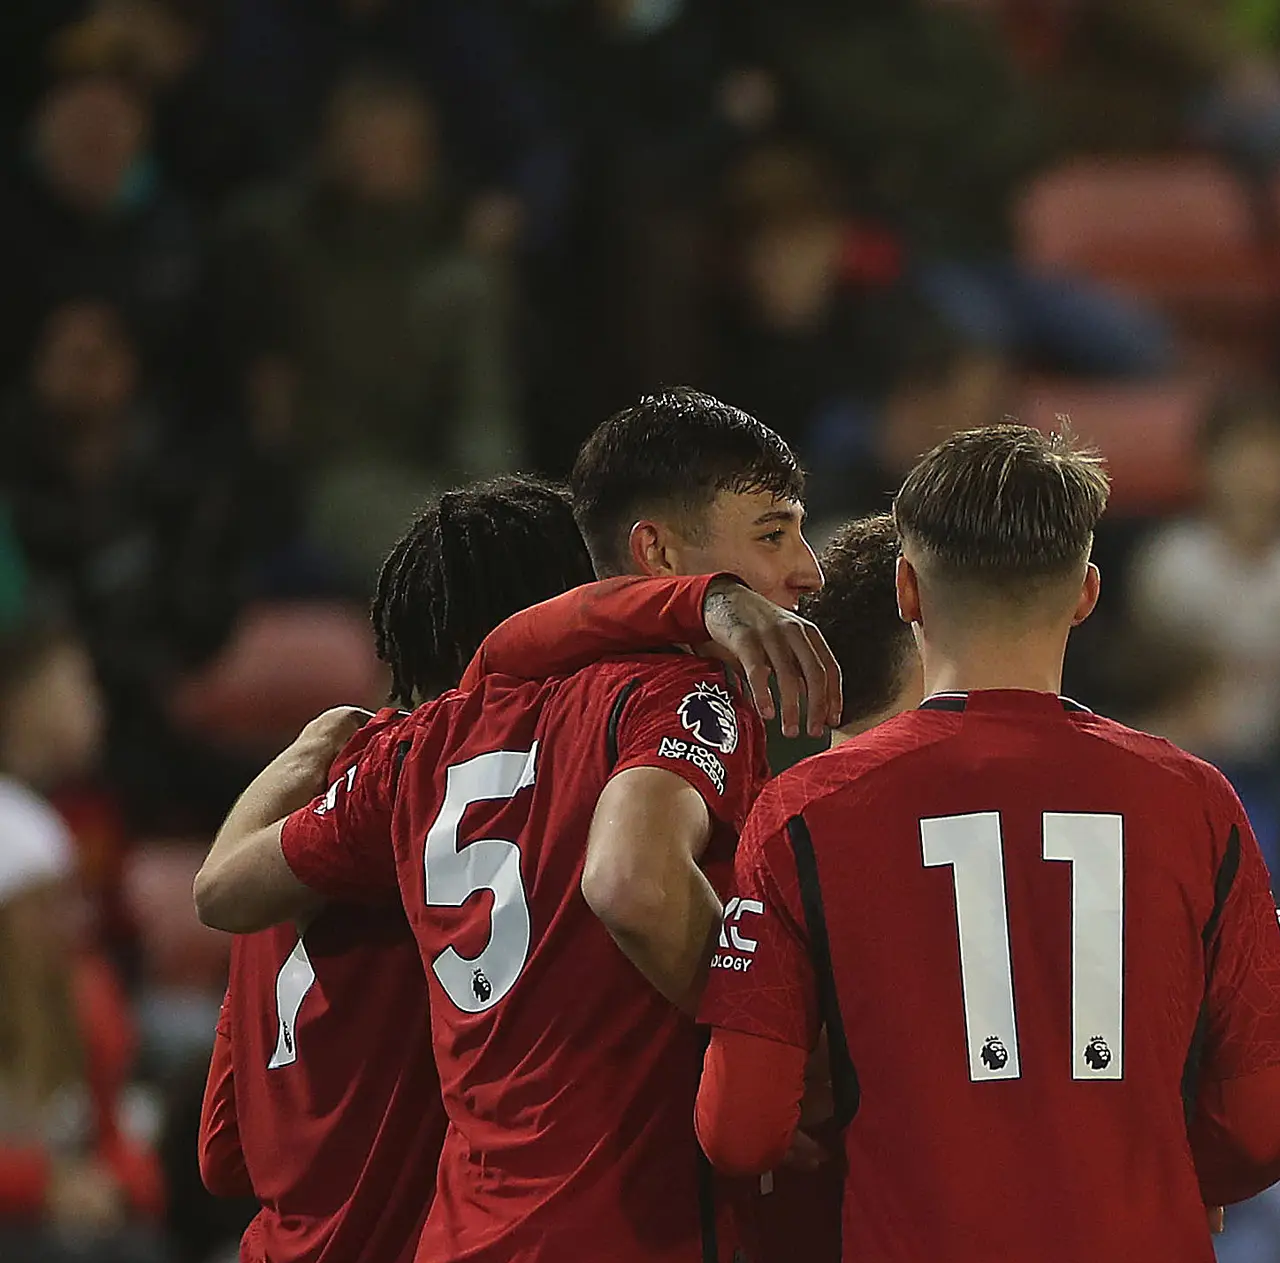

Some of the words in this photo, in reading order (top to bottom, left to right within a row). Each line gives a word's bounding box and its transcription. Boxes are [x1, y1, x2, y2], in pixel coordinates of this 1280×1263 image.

[424, 737, 541, 1014] 5
[661, 737, 687, 752] No
[689, 744, 726, 781] room
[919, 811, 1124, 1083] 11
